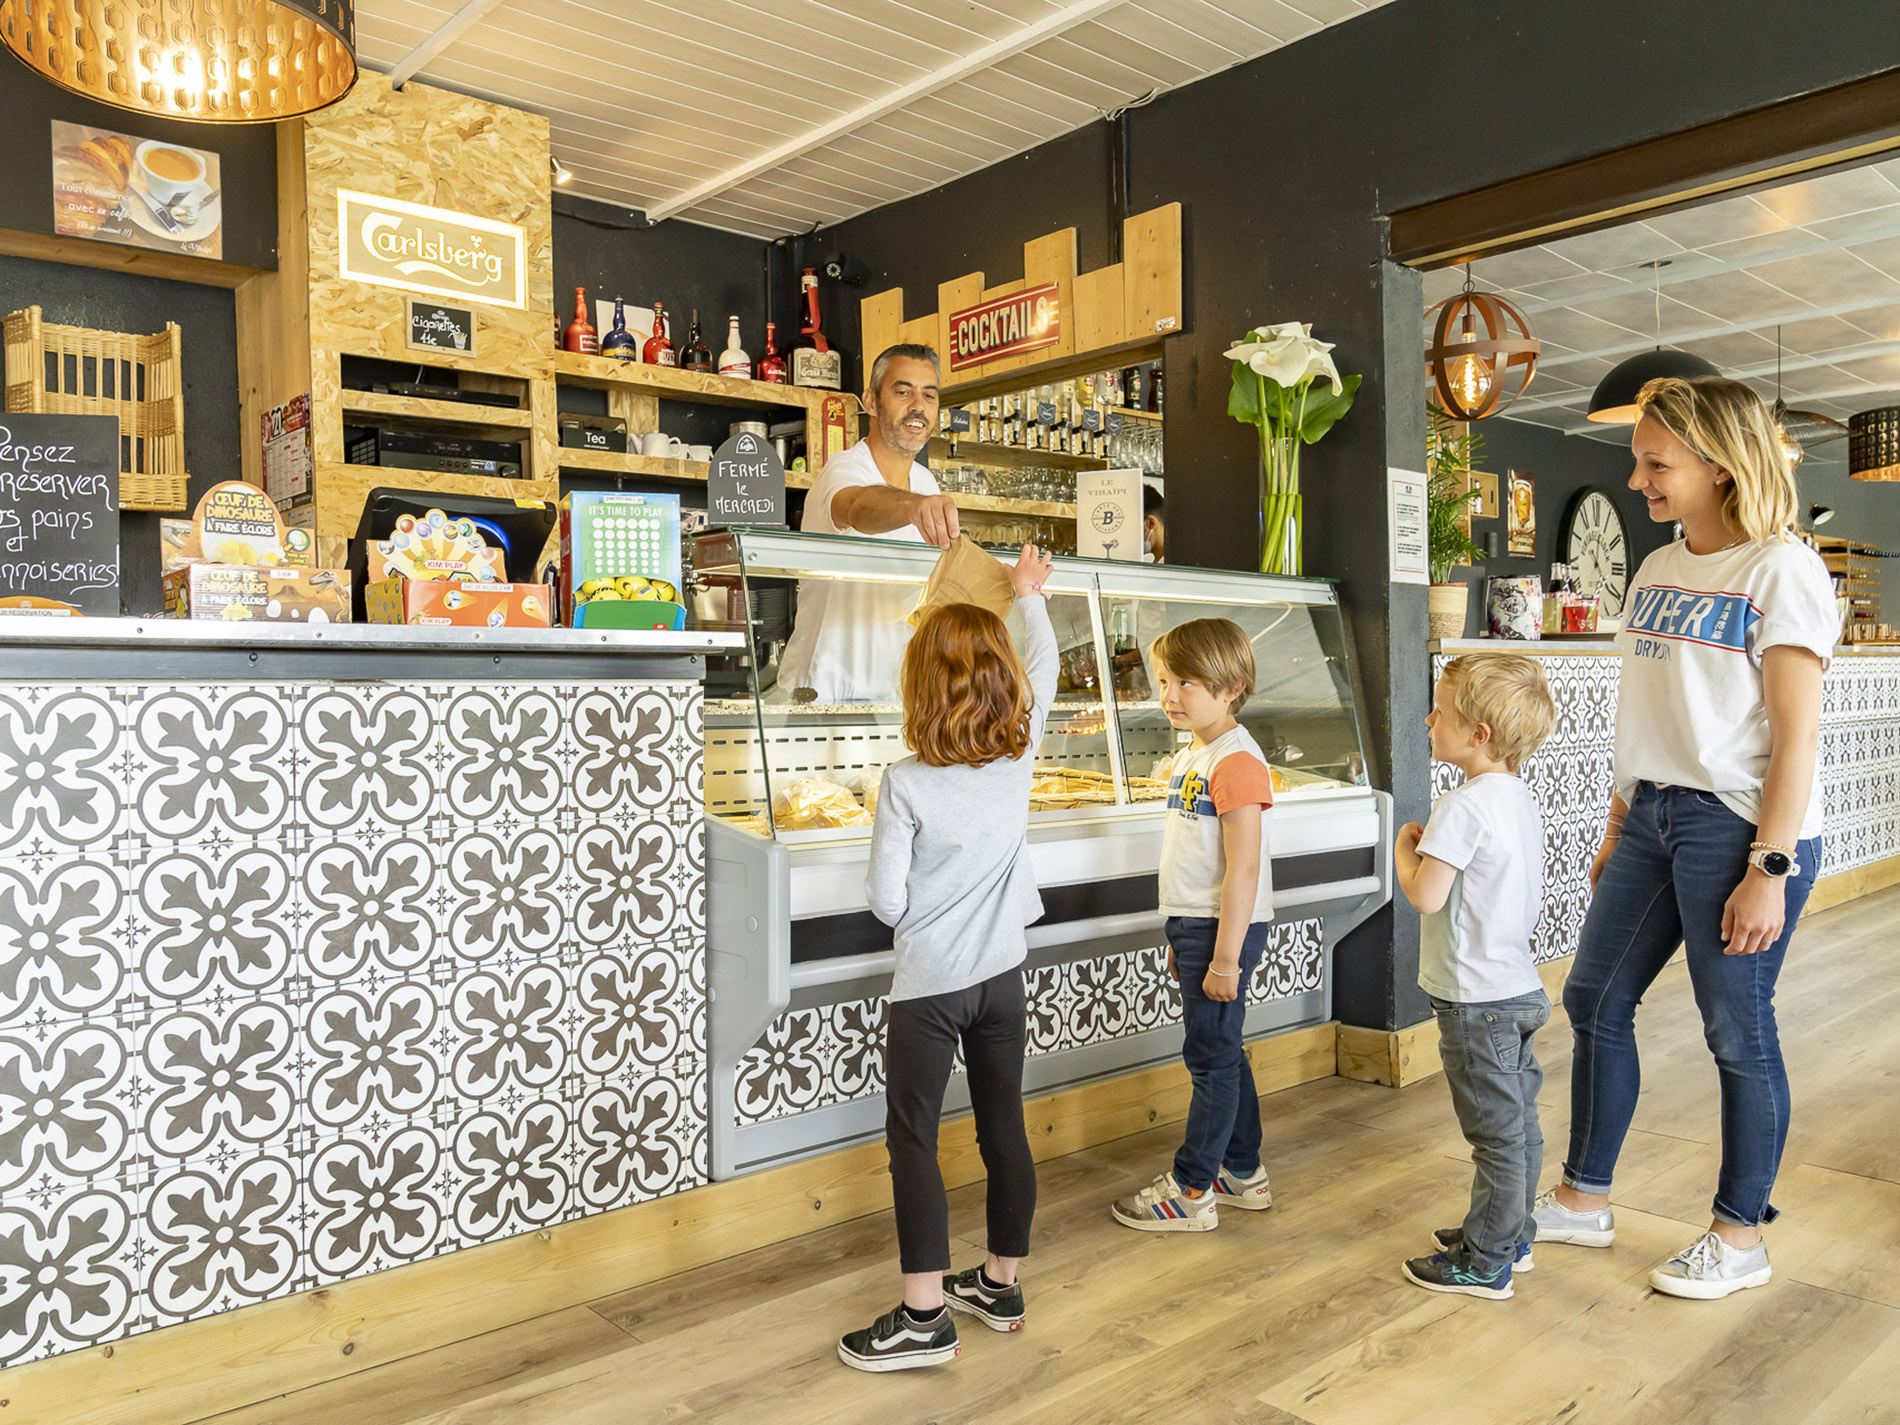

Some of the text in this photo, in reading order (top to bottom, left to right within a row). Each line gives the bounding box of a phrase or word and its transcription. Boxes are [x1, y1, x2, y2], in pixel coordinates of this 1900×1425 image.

[68, 203, 95, 213] avec
[361, 212, 503, 286] Carlsberg
[412, 315, 461, 334] Cigarettes
[957, 296, 1049, 358] COCKTAILS
[585, 432, 606, 444] Tea
[718, 457, 770, 478] FERMÉ
[736, 481, 749, 496] le
[247, 494, 265, 508] DE
[206, 504, 274, 523] DINOSAURE
[589, 506, 663, 517] IT'S TIME TO PLAY
[1102, 511, 1114, 525] B
[32, 508, 93, 540] pains
[215, 521, 240, 533] FAIRE
[242, 520, 275, 536] ÉCLORE
[6, 526, 29, 552] et
[1632, 590, 1714, 637] UPER
